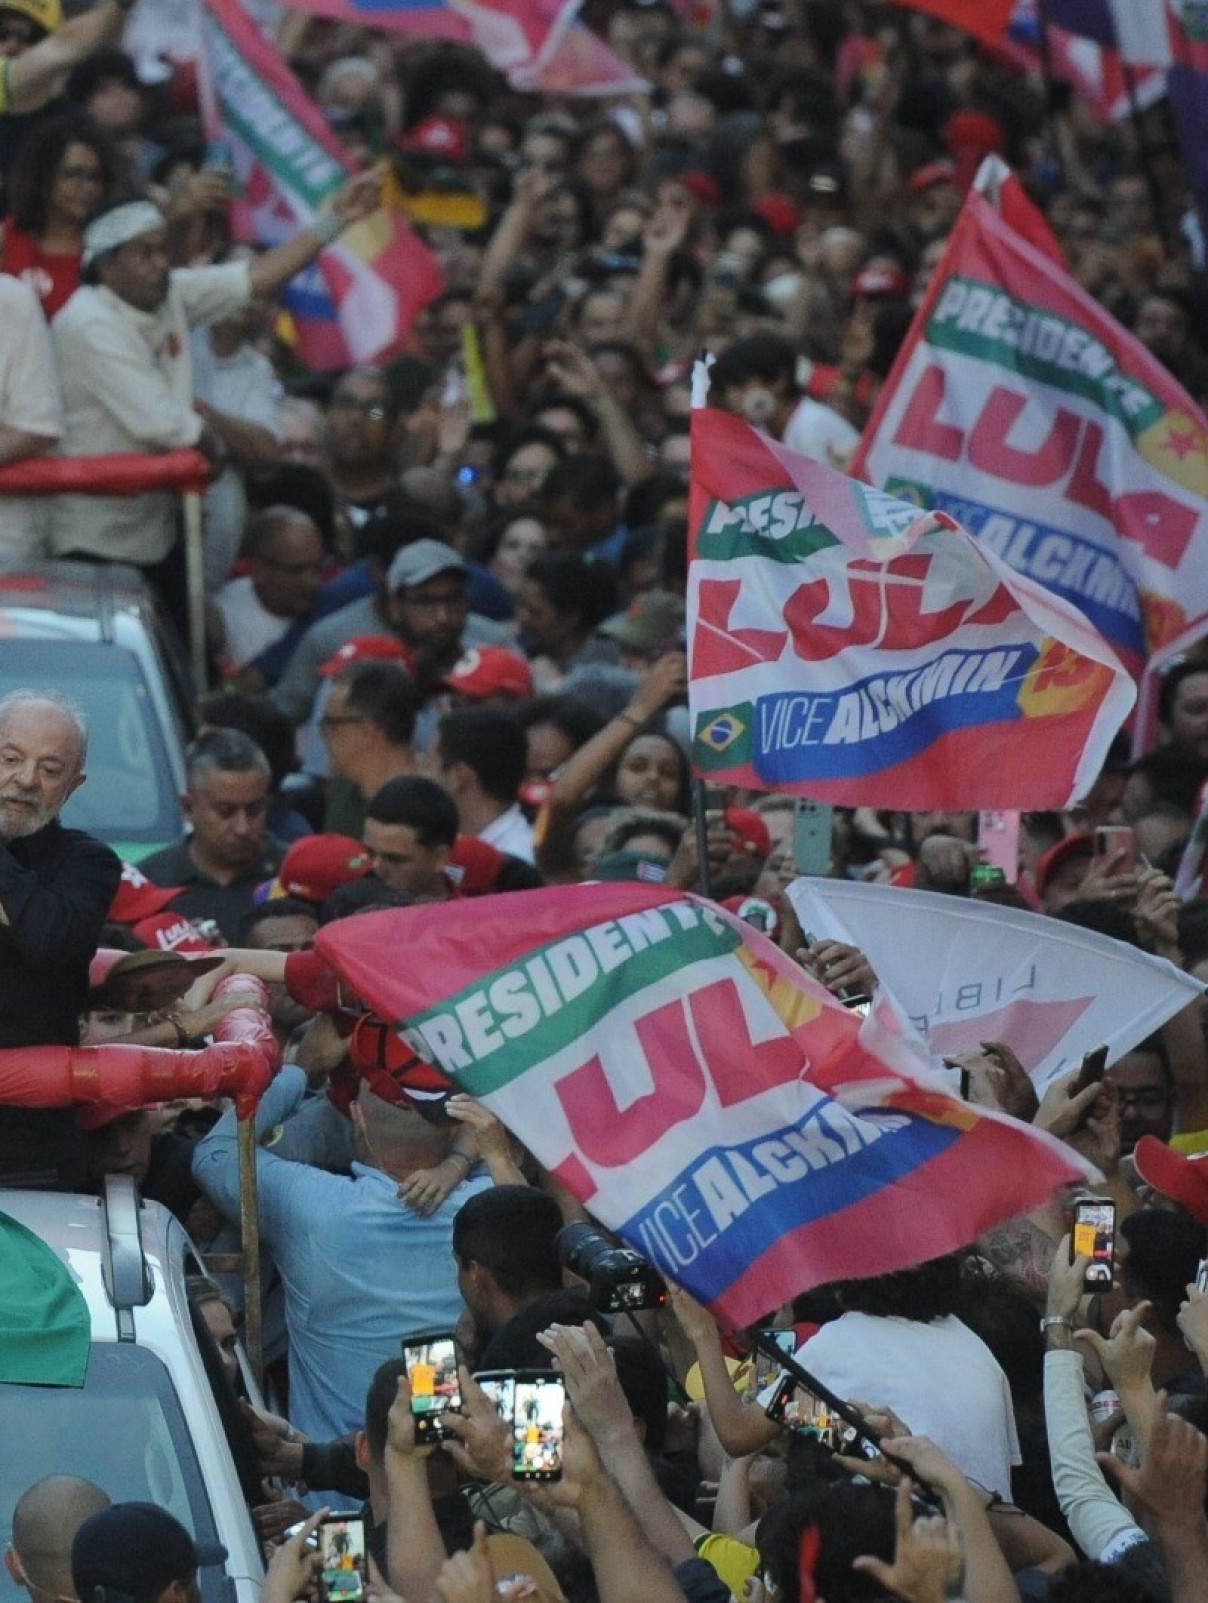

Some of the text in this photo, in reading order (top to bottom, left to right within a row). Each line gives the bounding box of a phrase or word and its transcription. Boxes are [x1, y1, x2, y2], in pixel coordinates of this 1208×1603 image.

[760, 651, 1023, 755] VICE ALCKMIN
[625, 1184, 719, 1275] VICE
